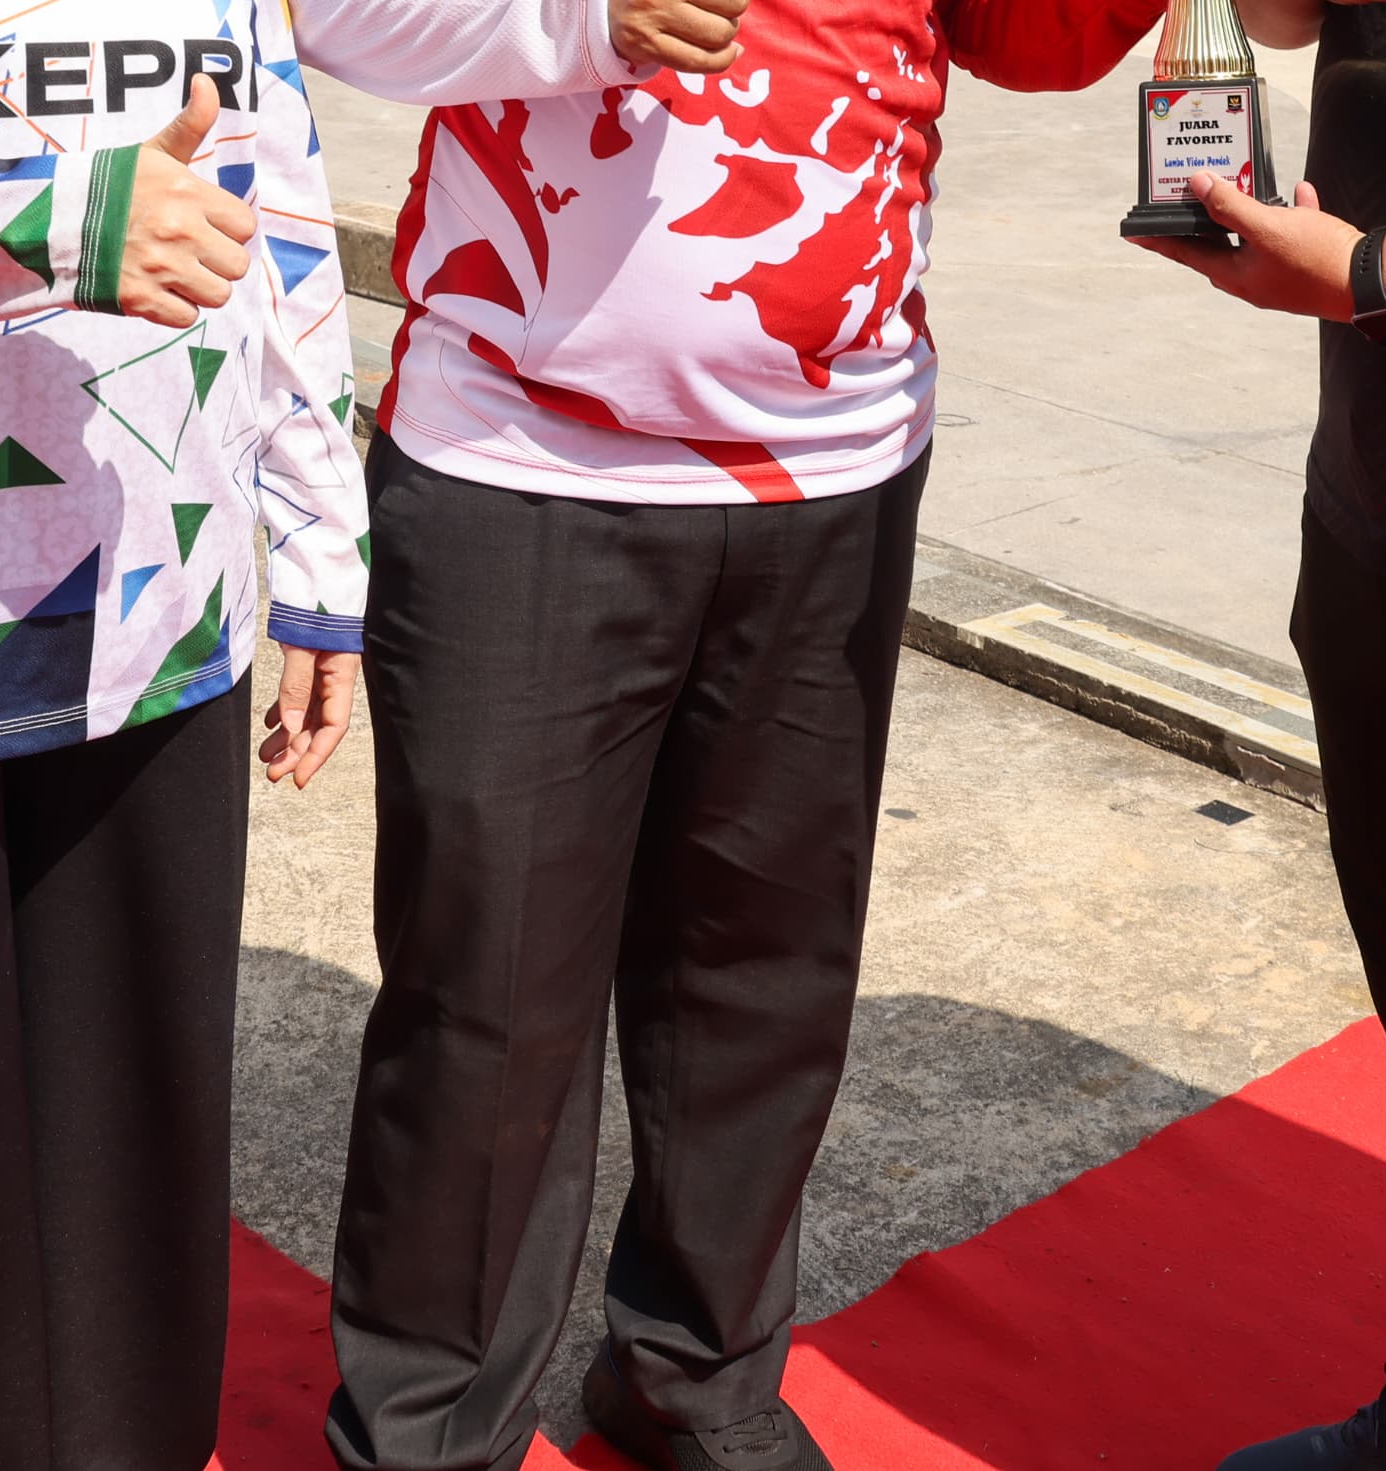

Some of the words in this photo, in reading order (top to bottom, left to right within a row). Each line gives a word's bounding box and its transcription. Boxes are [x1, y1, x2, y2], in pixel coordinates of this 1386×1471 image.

[1179, 120, 1220, 132] JUARA
[1166, 134, 1234, 146] FAVORITE
[1186, 156, 1205, 168] Video
